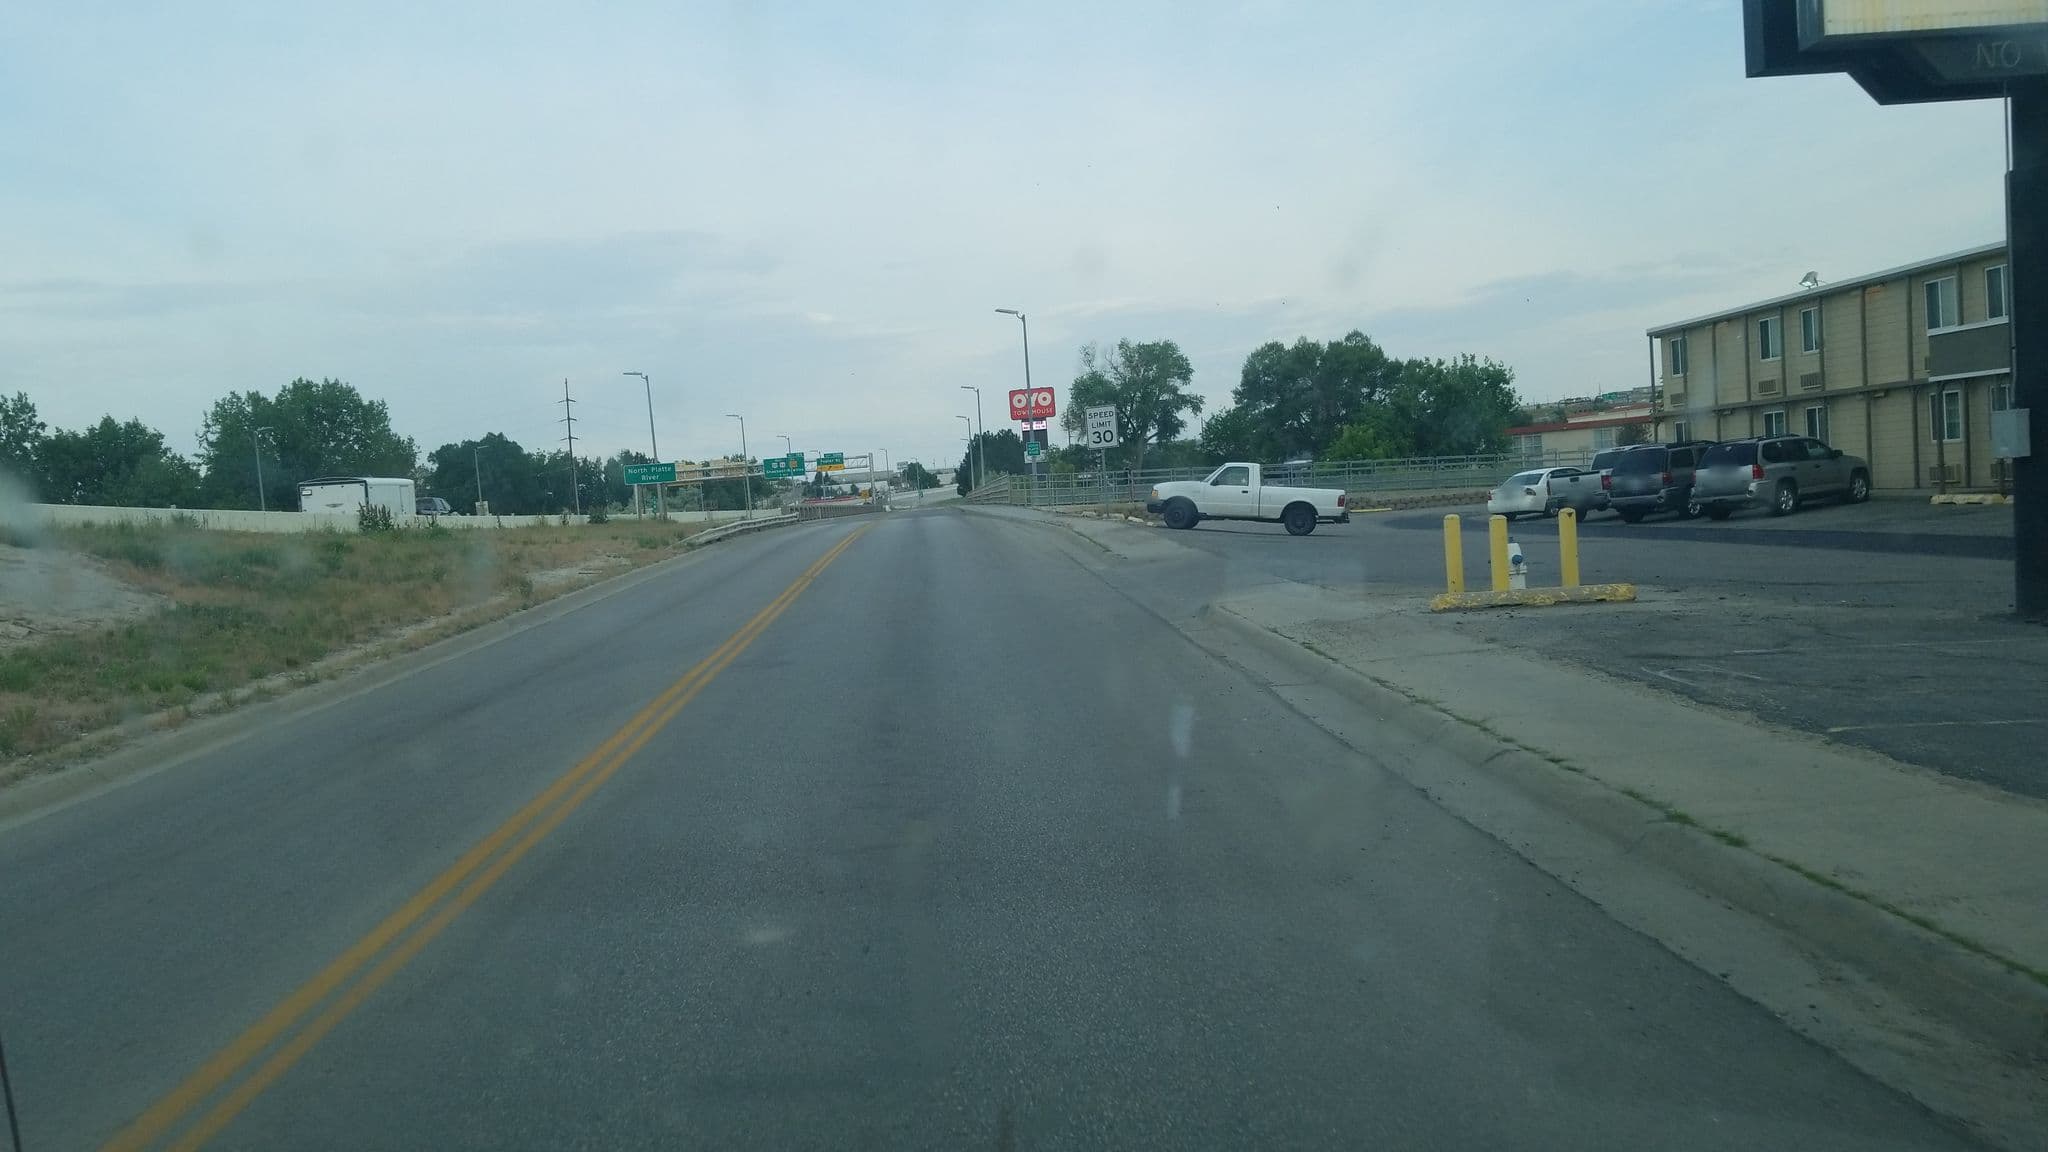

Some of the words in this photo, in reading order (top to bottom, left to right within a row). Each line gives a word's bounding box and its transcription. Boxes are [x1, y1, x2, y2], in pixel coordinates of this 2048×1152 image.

[1975, 39, 2022, 67] NO
[1013, 391, 1052, 409] OYO
[1088, 410, 1114, 419] SPEED
[1091, 420, 1111, 429] LIMIT
[1092, 430, 1113, 444] 30
